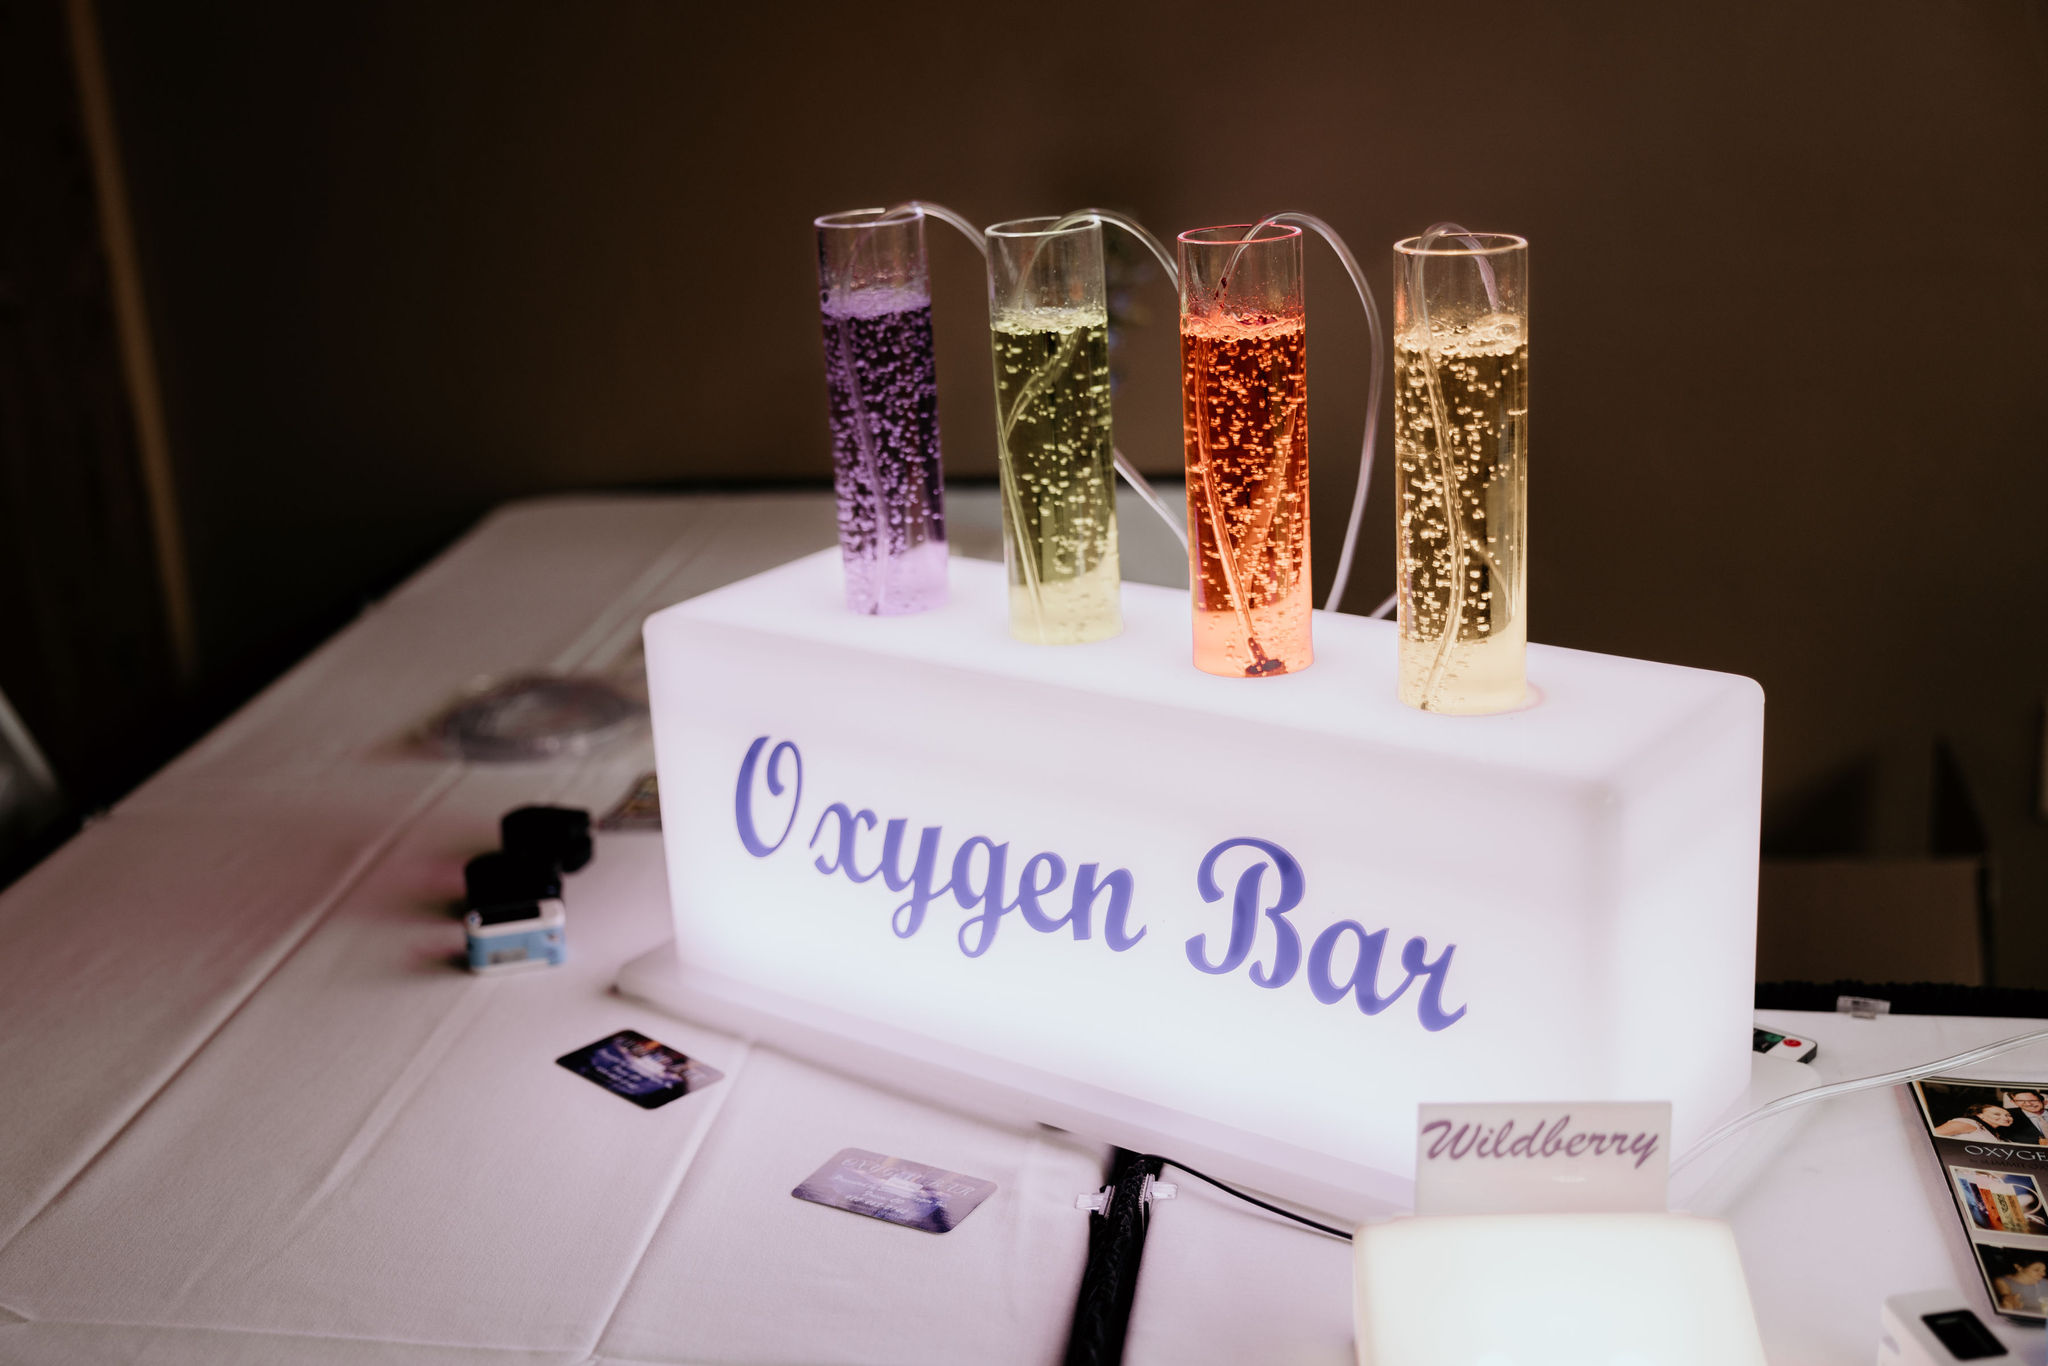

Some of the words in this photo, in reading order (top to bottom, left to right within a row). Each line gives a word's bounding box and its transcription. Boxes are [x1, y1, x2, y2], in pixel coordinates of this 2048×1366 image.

[735, 735, 1147, 958] Oxygen
[1185, 836, 1467, 1032] Bar
[1420, 1114, 1659, 1170] Wildberry
